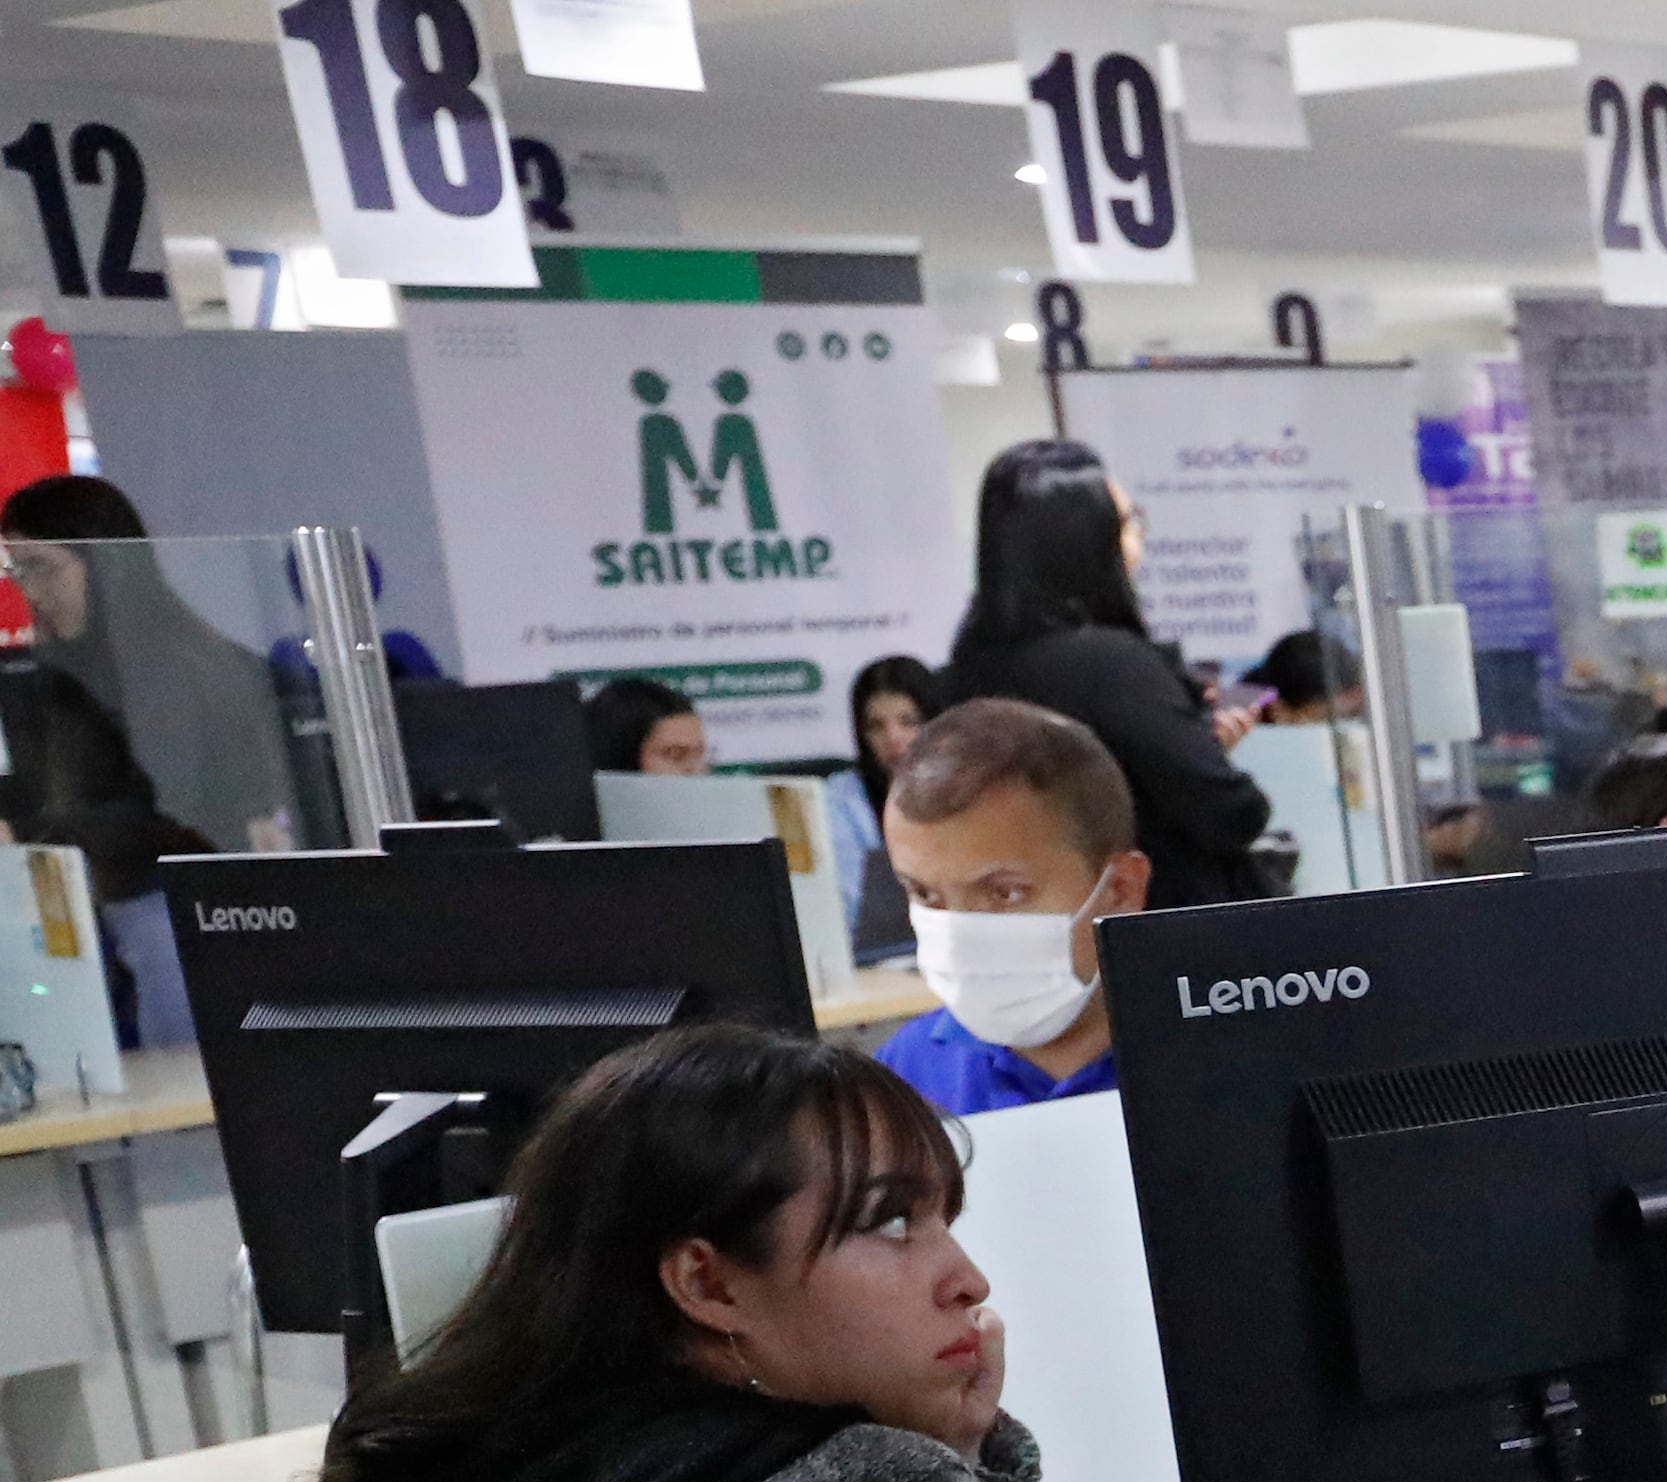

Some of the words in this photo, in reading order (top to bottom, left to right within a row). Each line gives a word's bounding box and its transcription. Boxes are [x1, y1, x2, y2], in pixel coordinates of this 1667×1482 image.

[281, 0, 502, 218] 18
[1030, 50, 1175, 250] 19
[3, 121, 168, 299] 12
[196, 901, 297, 933] Lenovo
[1177, 965, 1371, 1019] Lenovo
